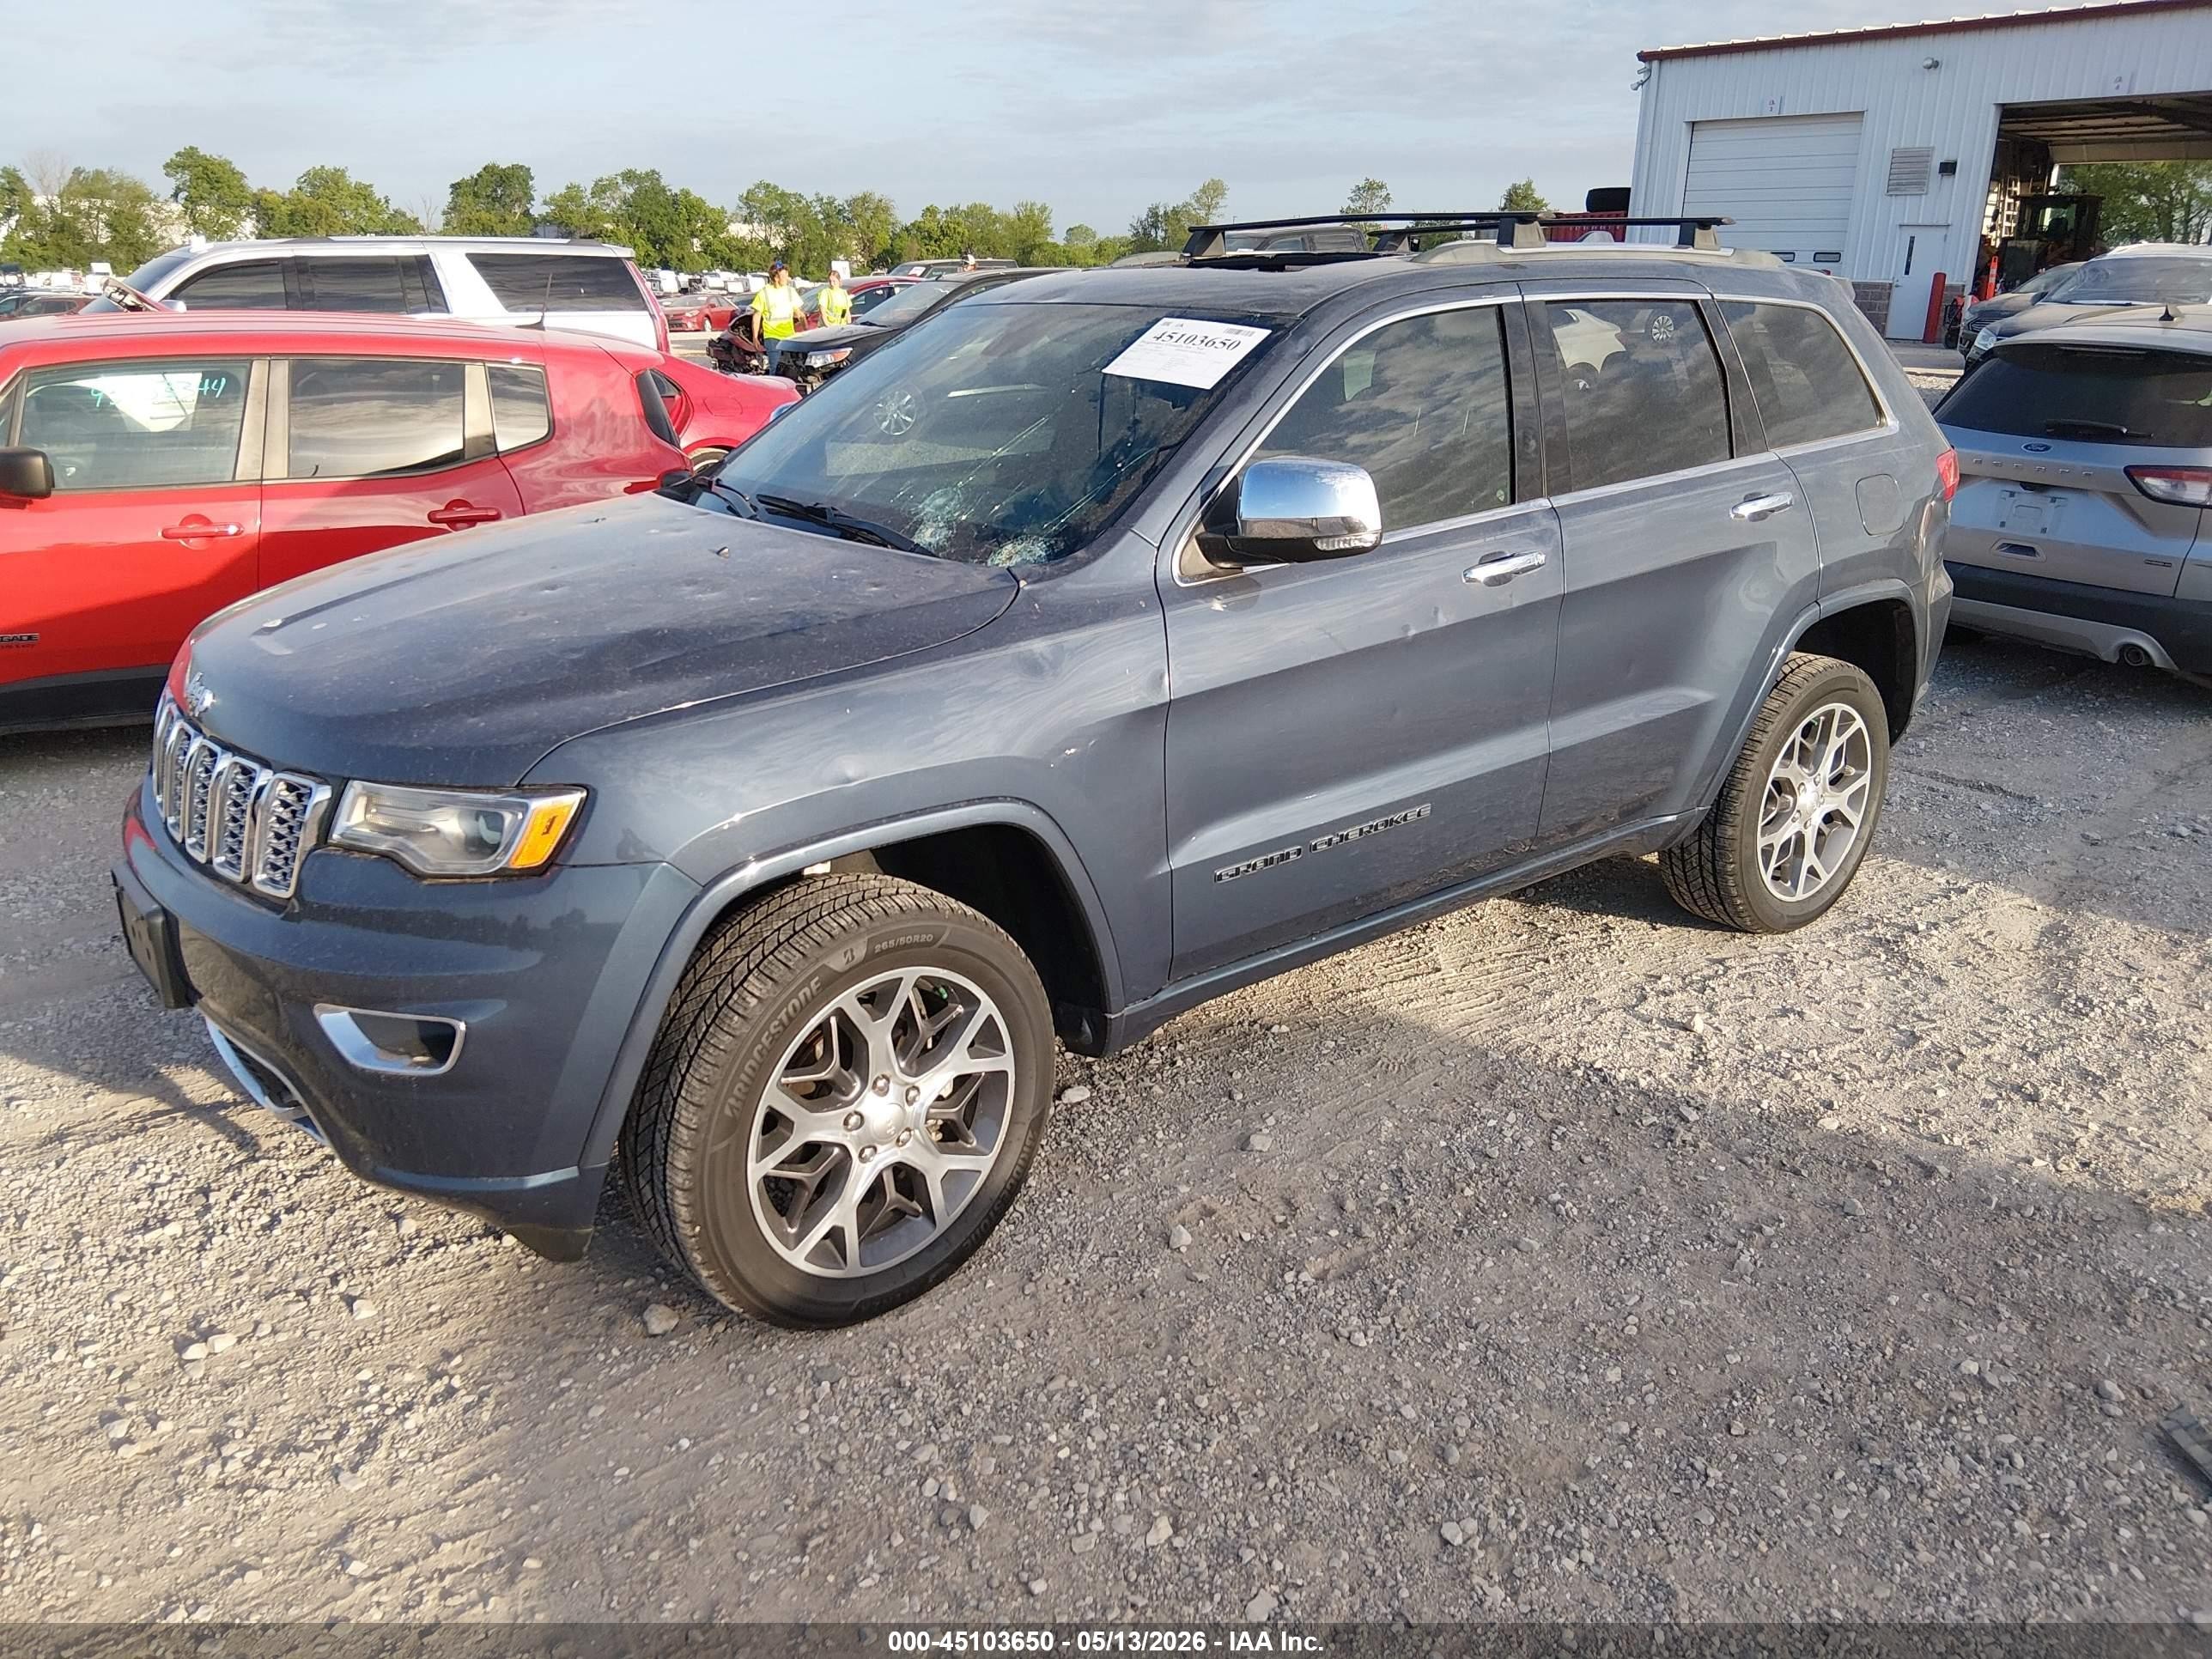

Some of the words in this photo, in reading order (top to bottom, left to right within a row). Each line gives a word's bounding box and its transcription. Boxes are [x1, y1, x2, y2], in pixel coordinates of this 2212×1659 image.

[1152, 330, 1243, 351] 45103650
[1214, 846, 1303, 884] GRAND
[1310, 804, 1431, 853] CHEROKEE
[874, 933, 934, 954] 265/50R20
[724, 976, 822, 1120] BRIDGESTONE
